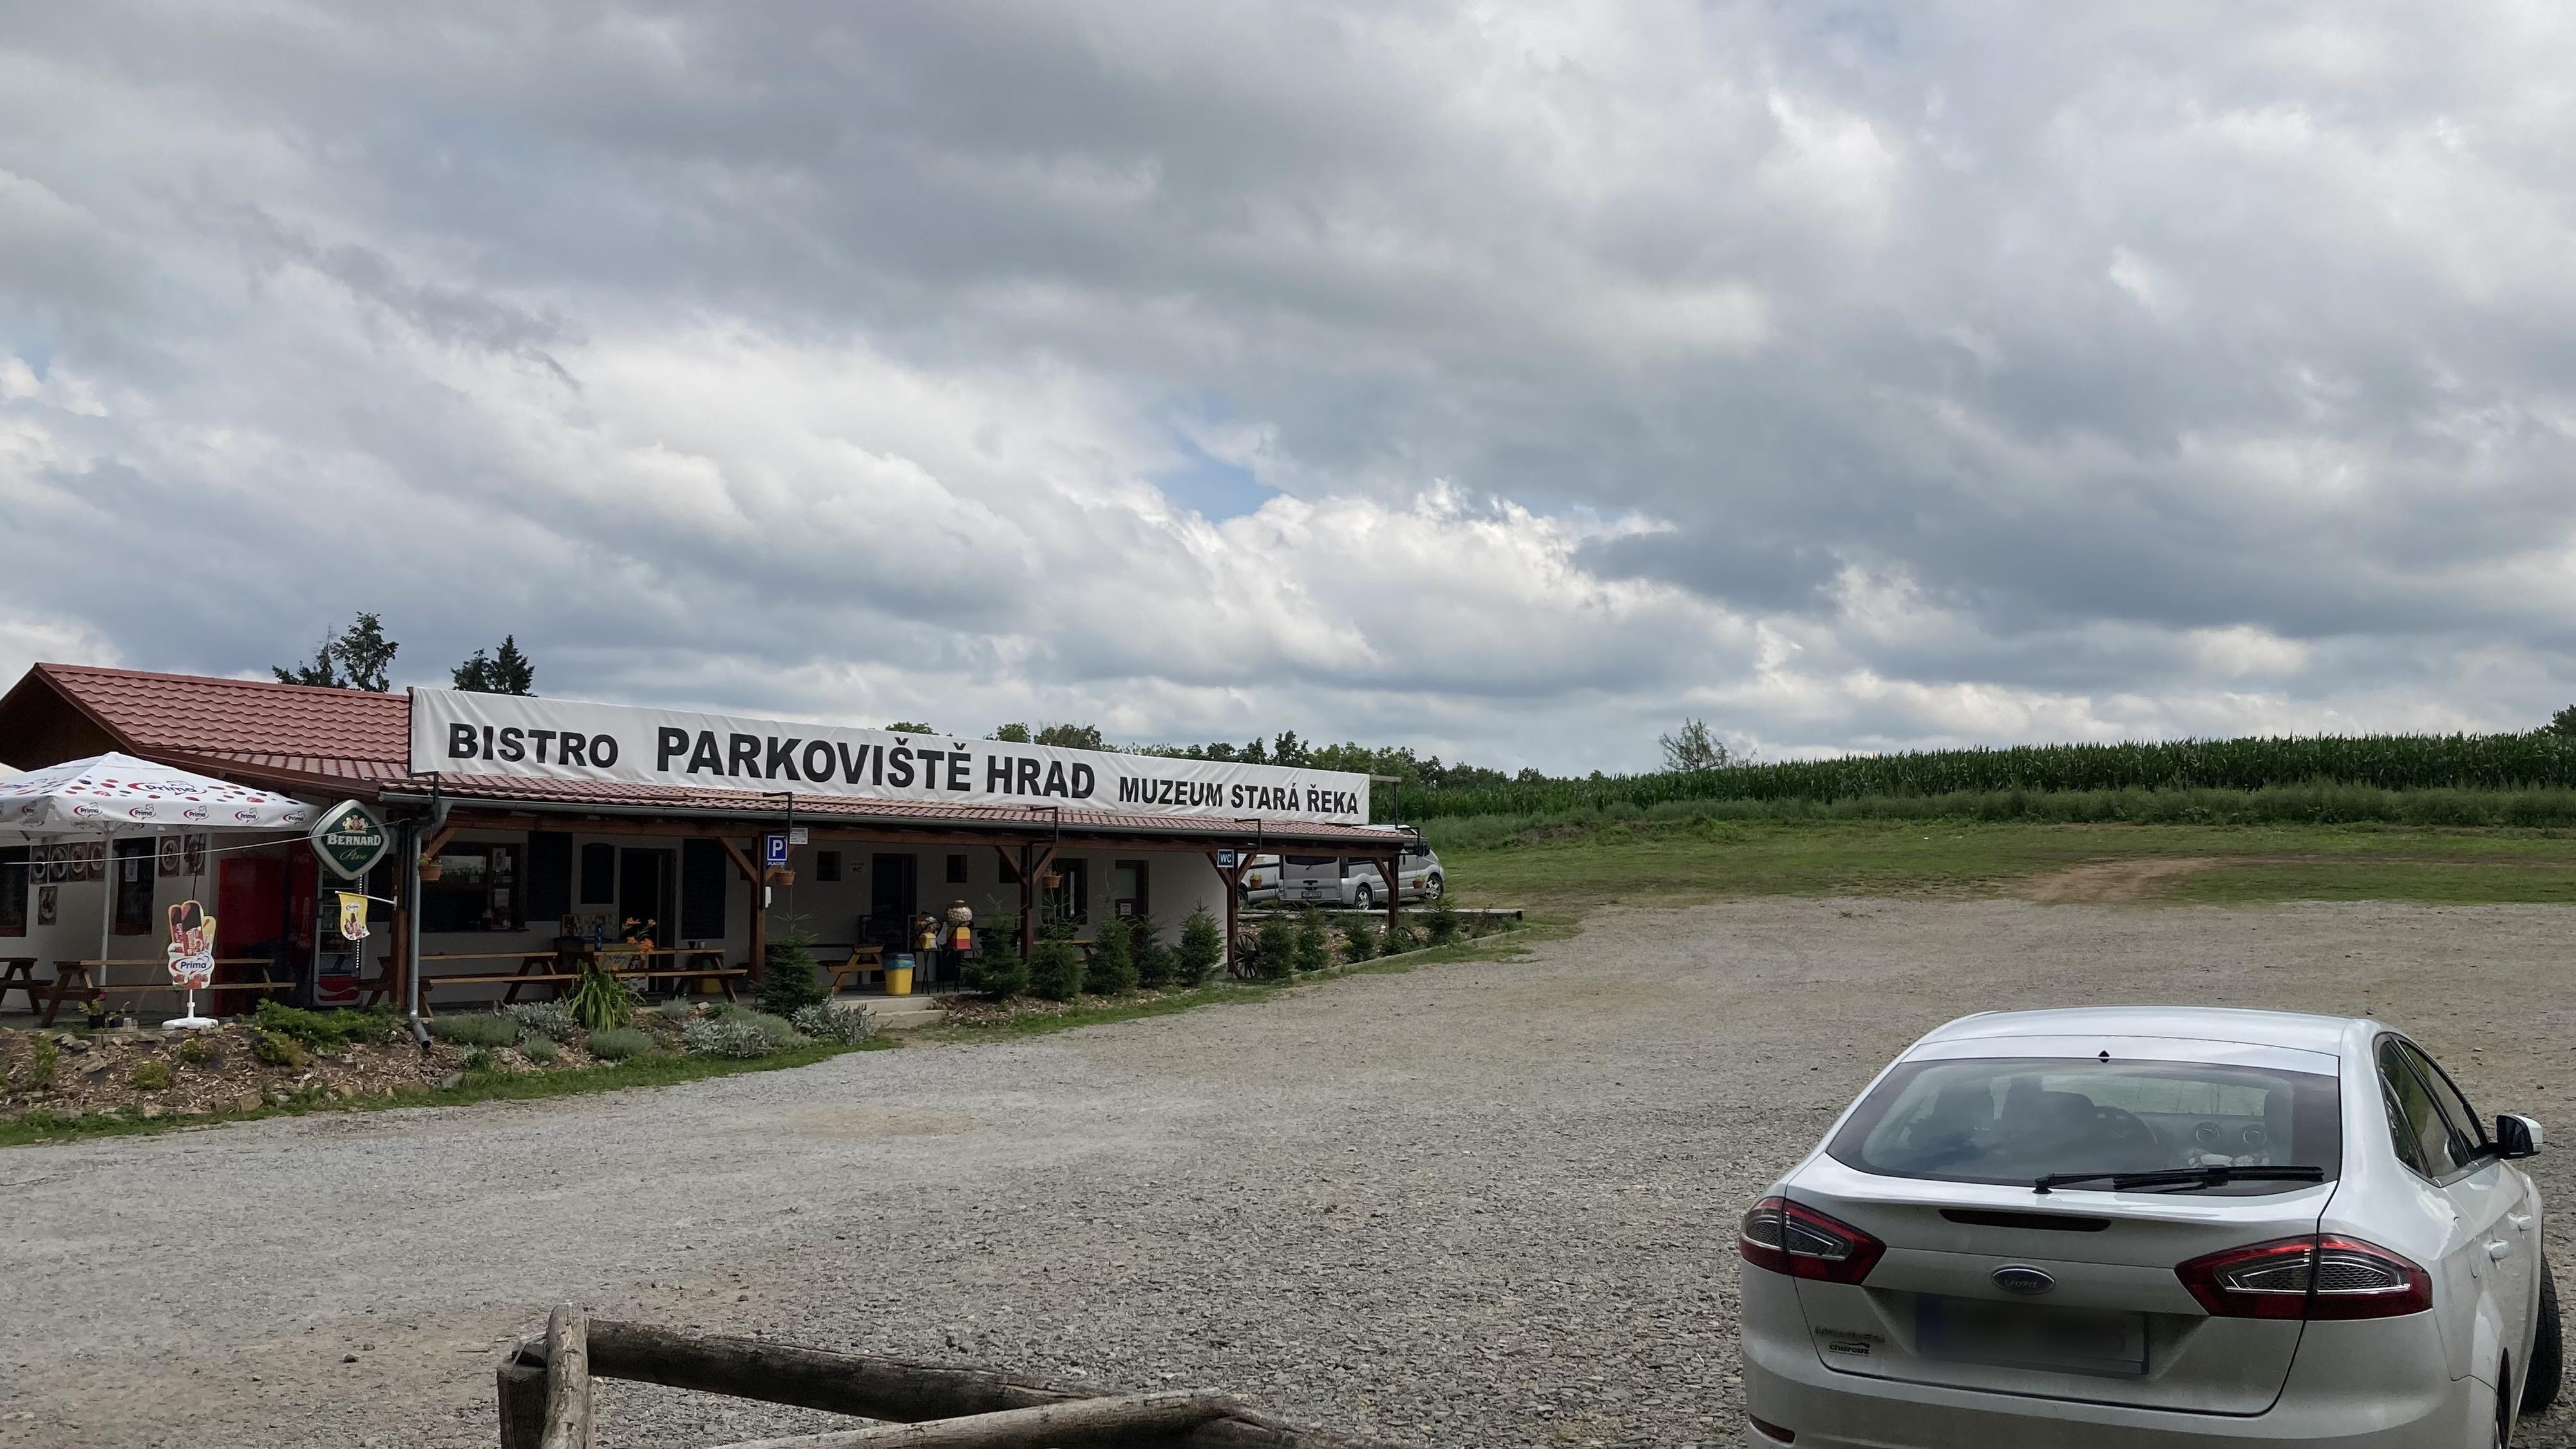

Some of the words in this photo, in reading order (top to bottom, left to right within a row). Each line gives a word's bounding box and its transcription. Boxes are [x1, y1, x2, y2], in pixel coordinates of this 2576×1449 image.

[448, 723, 618, 768] BISTRO
[657, 726, 971, 791] PARKOVIŠTĚ
[986, 755, 1095, 799] HRAD
[1119, 776, 1223, 807] MUZEUM
[1231, 782, 1300, 811] STARÁ
[1307, 783, 1359, 815] ŘEKA
[145, 784, 197, 793] Prima
[327, 834, 381, 846] BERNARD
[773, 839, 783, 857] P
[1220, 854, 1231, 863] WC
